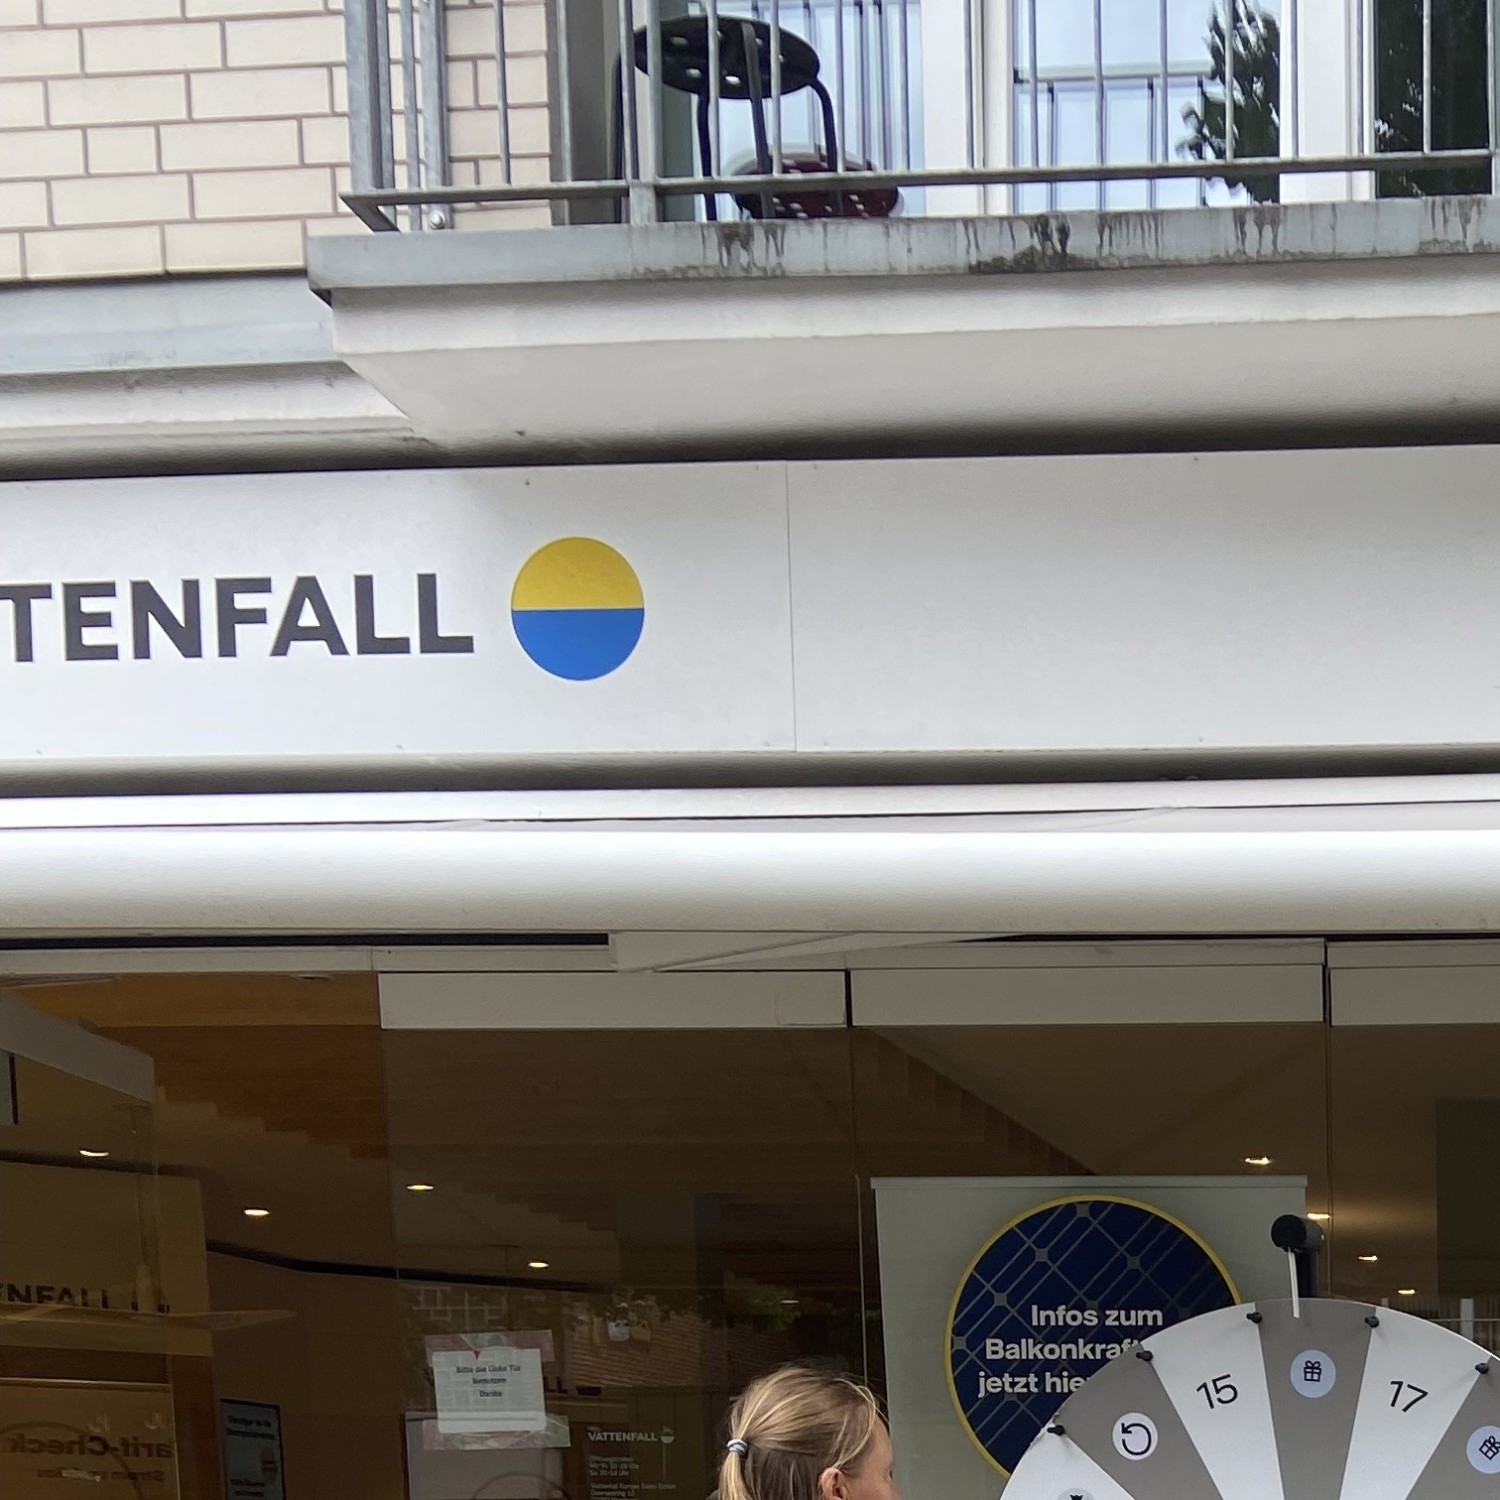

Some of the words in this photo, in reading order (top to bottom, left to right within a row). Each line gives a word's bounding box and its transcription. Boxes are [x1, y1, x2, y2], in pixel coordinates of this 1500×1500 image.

[0, 573, 475, 663] TENFALL
[1031, 1304, 1099, 1327] Infos
[1104, 1308, 1164, 1327] zum
[985, 1338, 1138, 1360] Balkonkraf
[977, 1371, 1039, 1399] jetzt
[1045, 1371, 1090, 1394] hie
[1196, 1373, 1239, 1410] 15
[1389, 1379, 1429, 1413] 17
[588, 1431, 658, 1442] VATTENFALL
